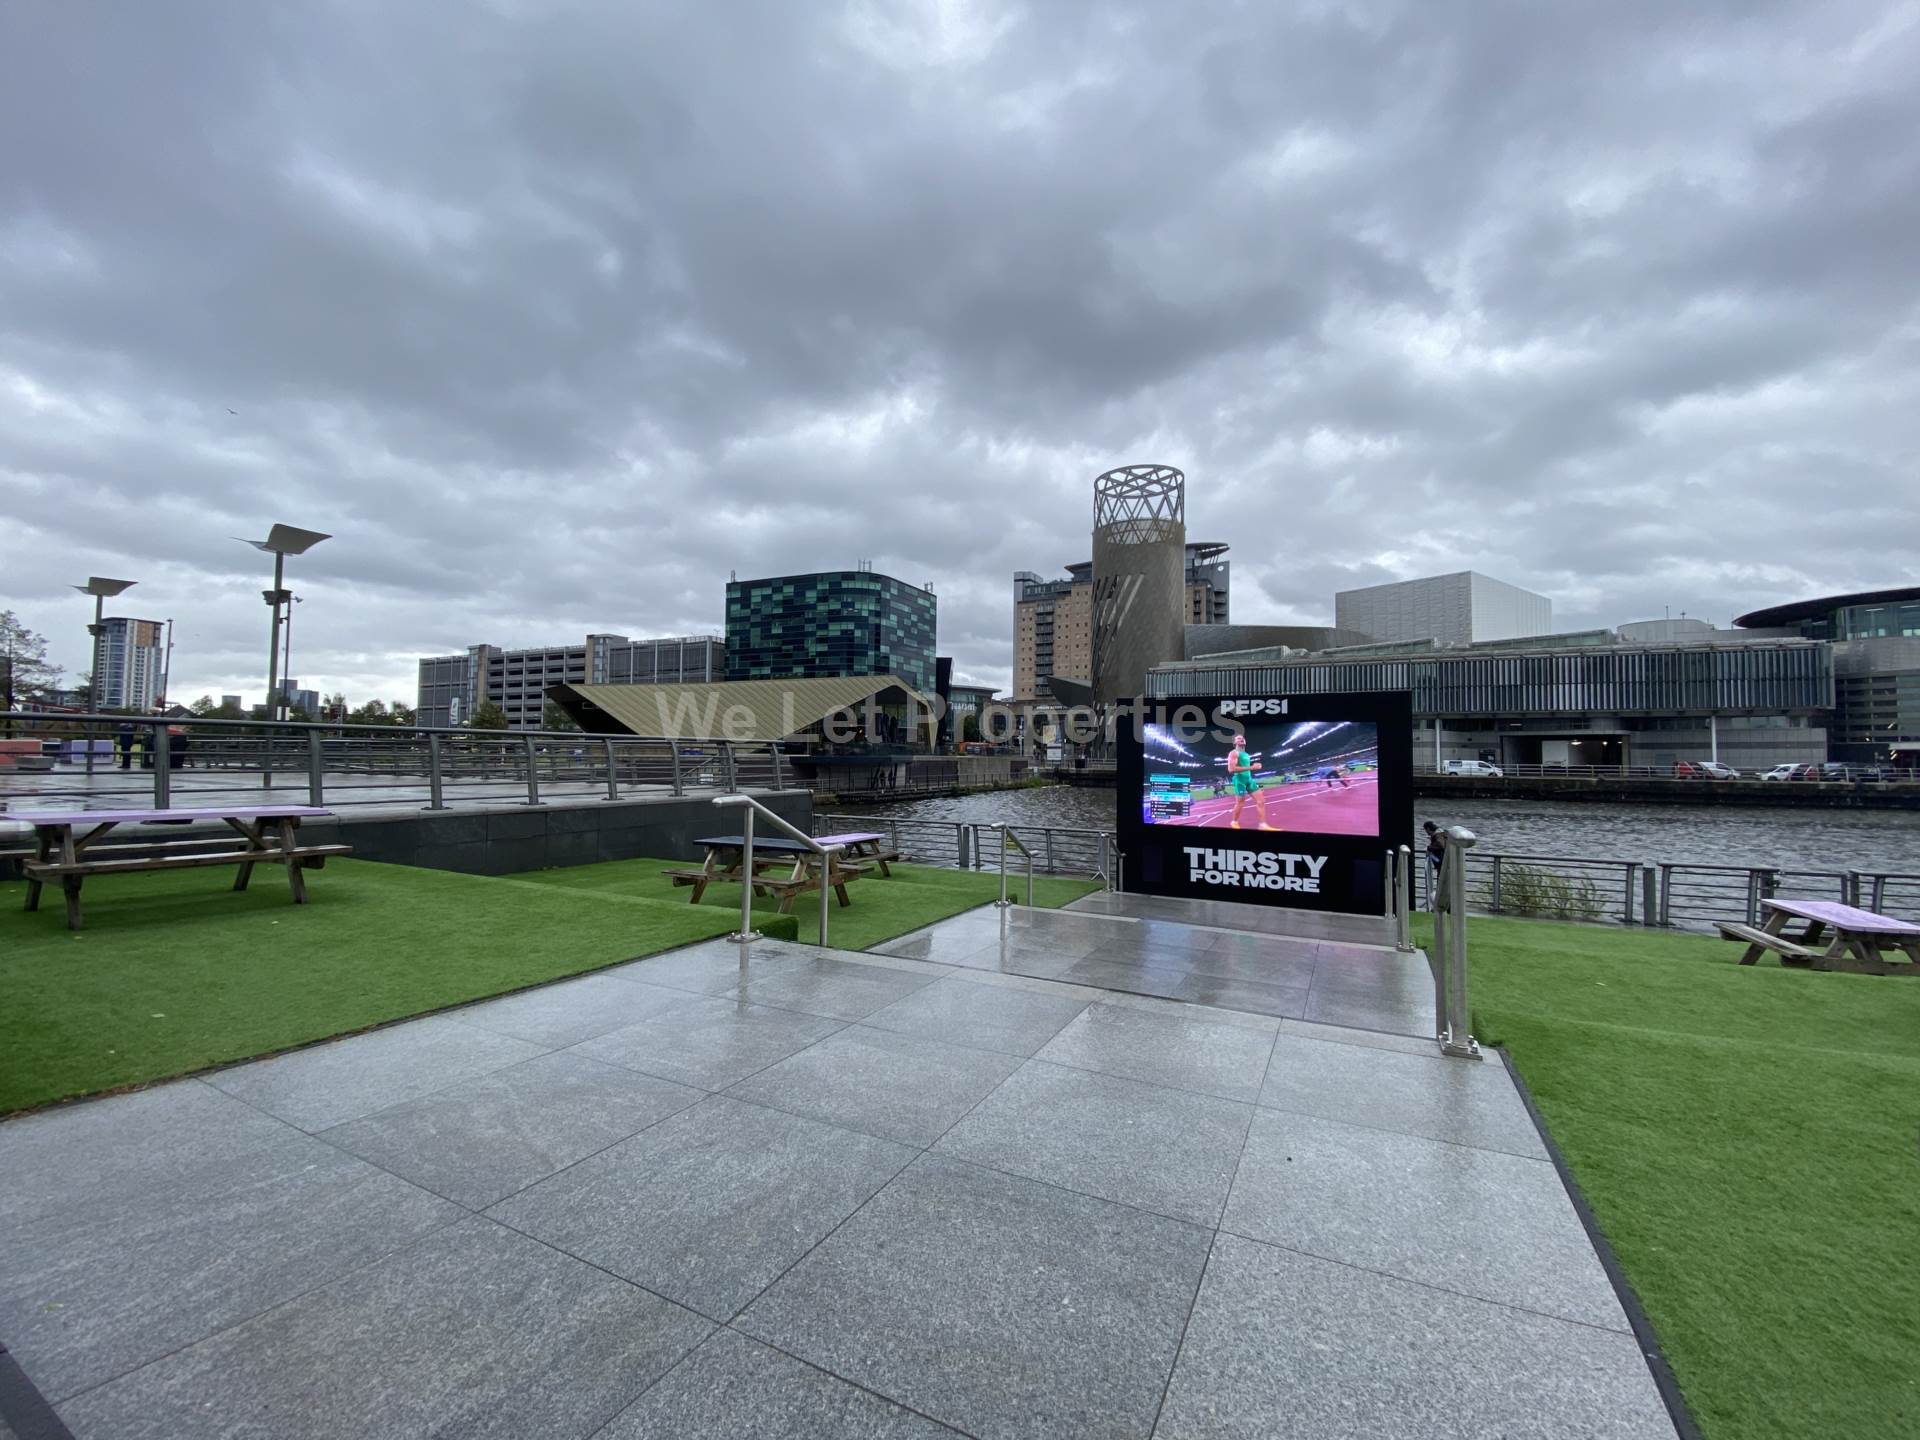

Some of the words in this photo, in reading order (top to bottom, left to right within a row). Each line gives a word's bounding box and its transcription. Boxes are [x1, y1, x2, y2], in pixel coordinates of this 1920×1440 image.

[1220, 698, 1288, 715] PEPSI
[1183, 847, 1329, 878] THIRSTY
[1190, 868, 1240, 886] FOR
[1244, 872, 1320, 893] MORE
